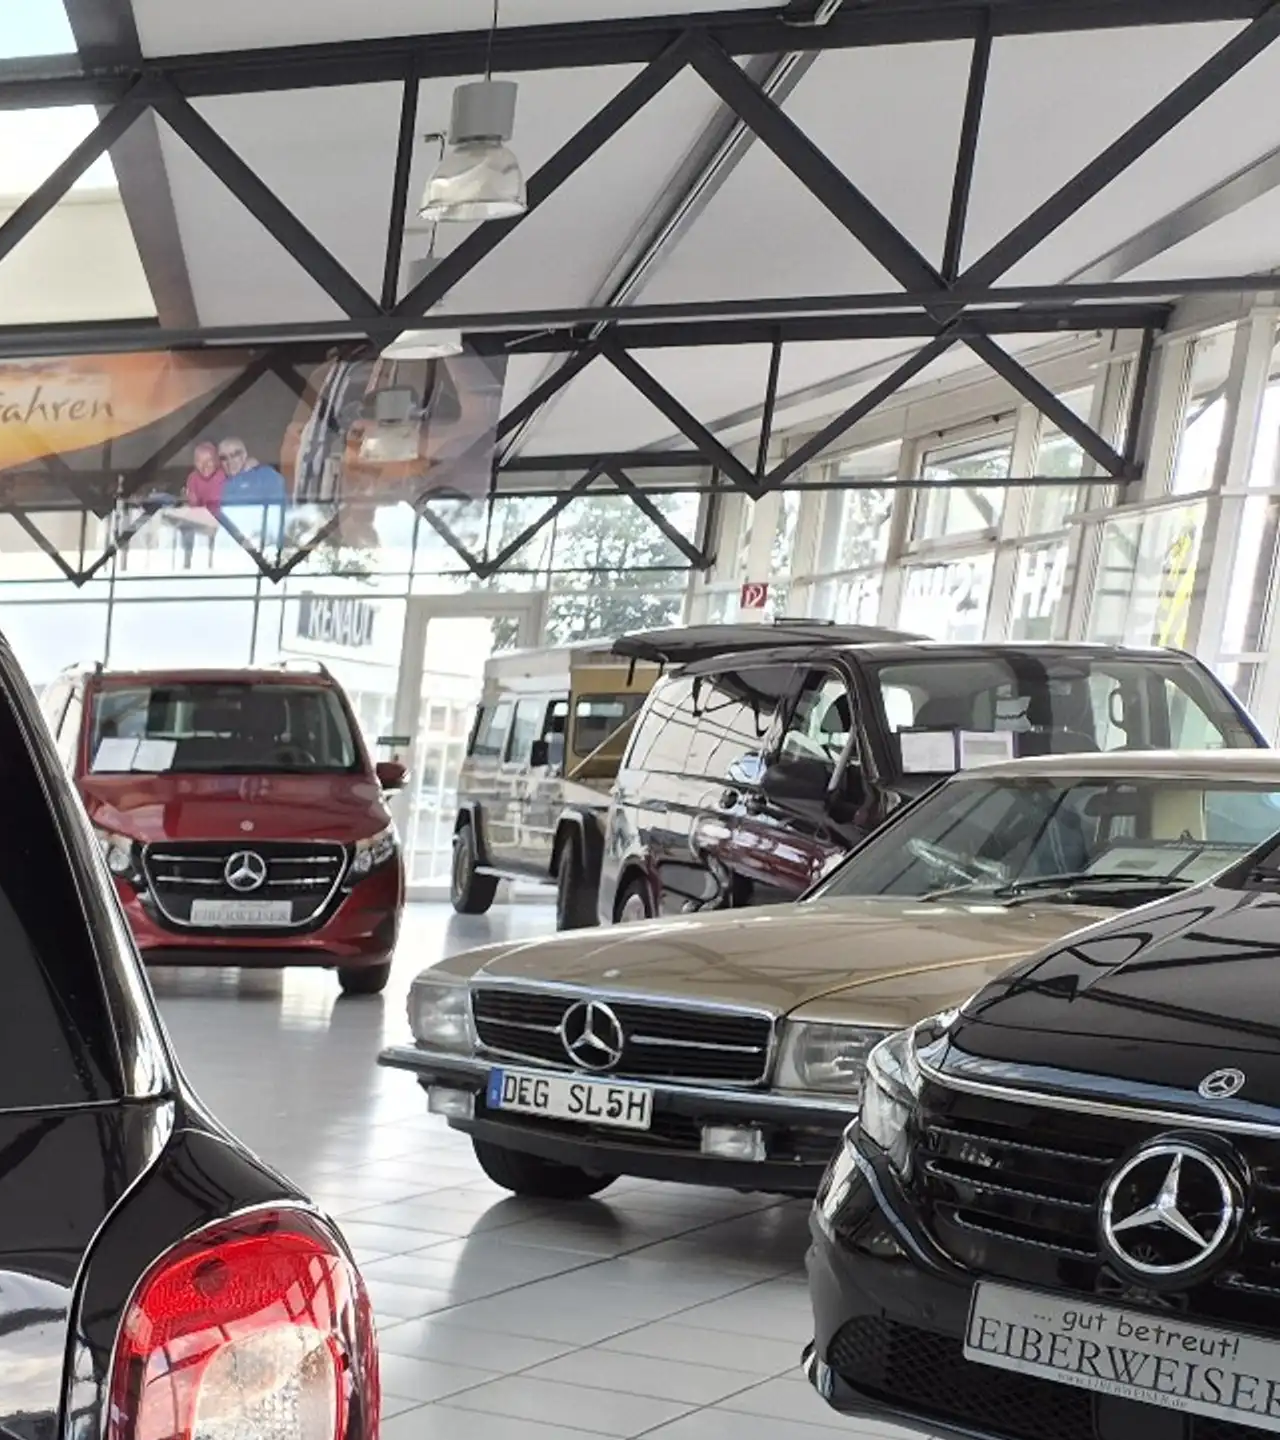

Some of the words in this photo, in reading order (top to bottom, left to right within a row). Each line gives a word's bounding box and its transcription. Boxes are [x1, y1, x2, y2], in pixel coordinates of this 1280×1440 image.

[307, 597, 382, 647] RENAUL
[502, 1075, 550, 1109] DEG
[568, 1083, 647, 1122] SL5H
[1062, 1309, 1107, 1333] gut
[1116, 1314, 1241, 1361] betreut!
